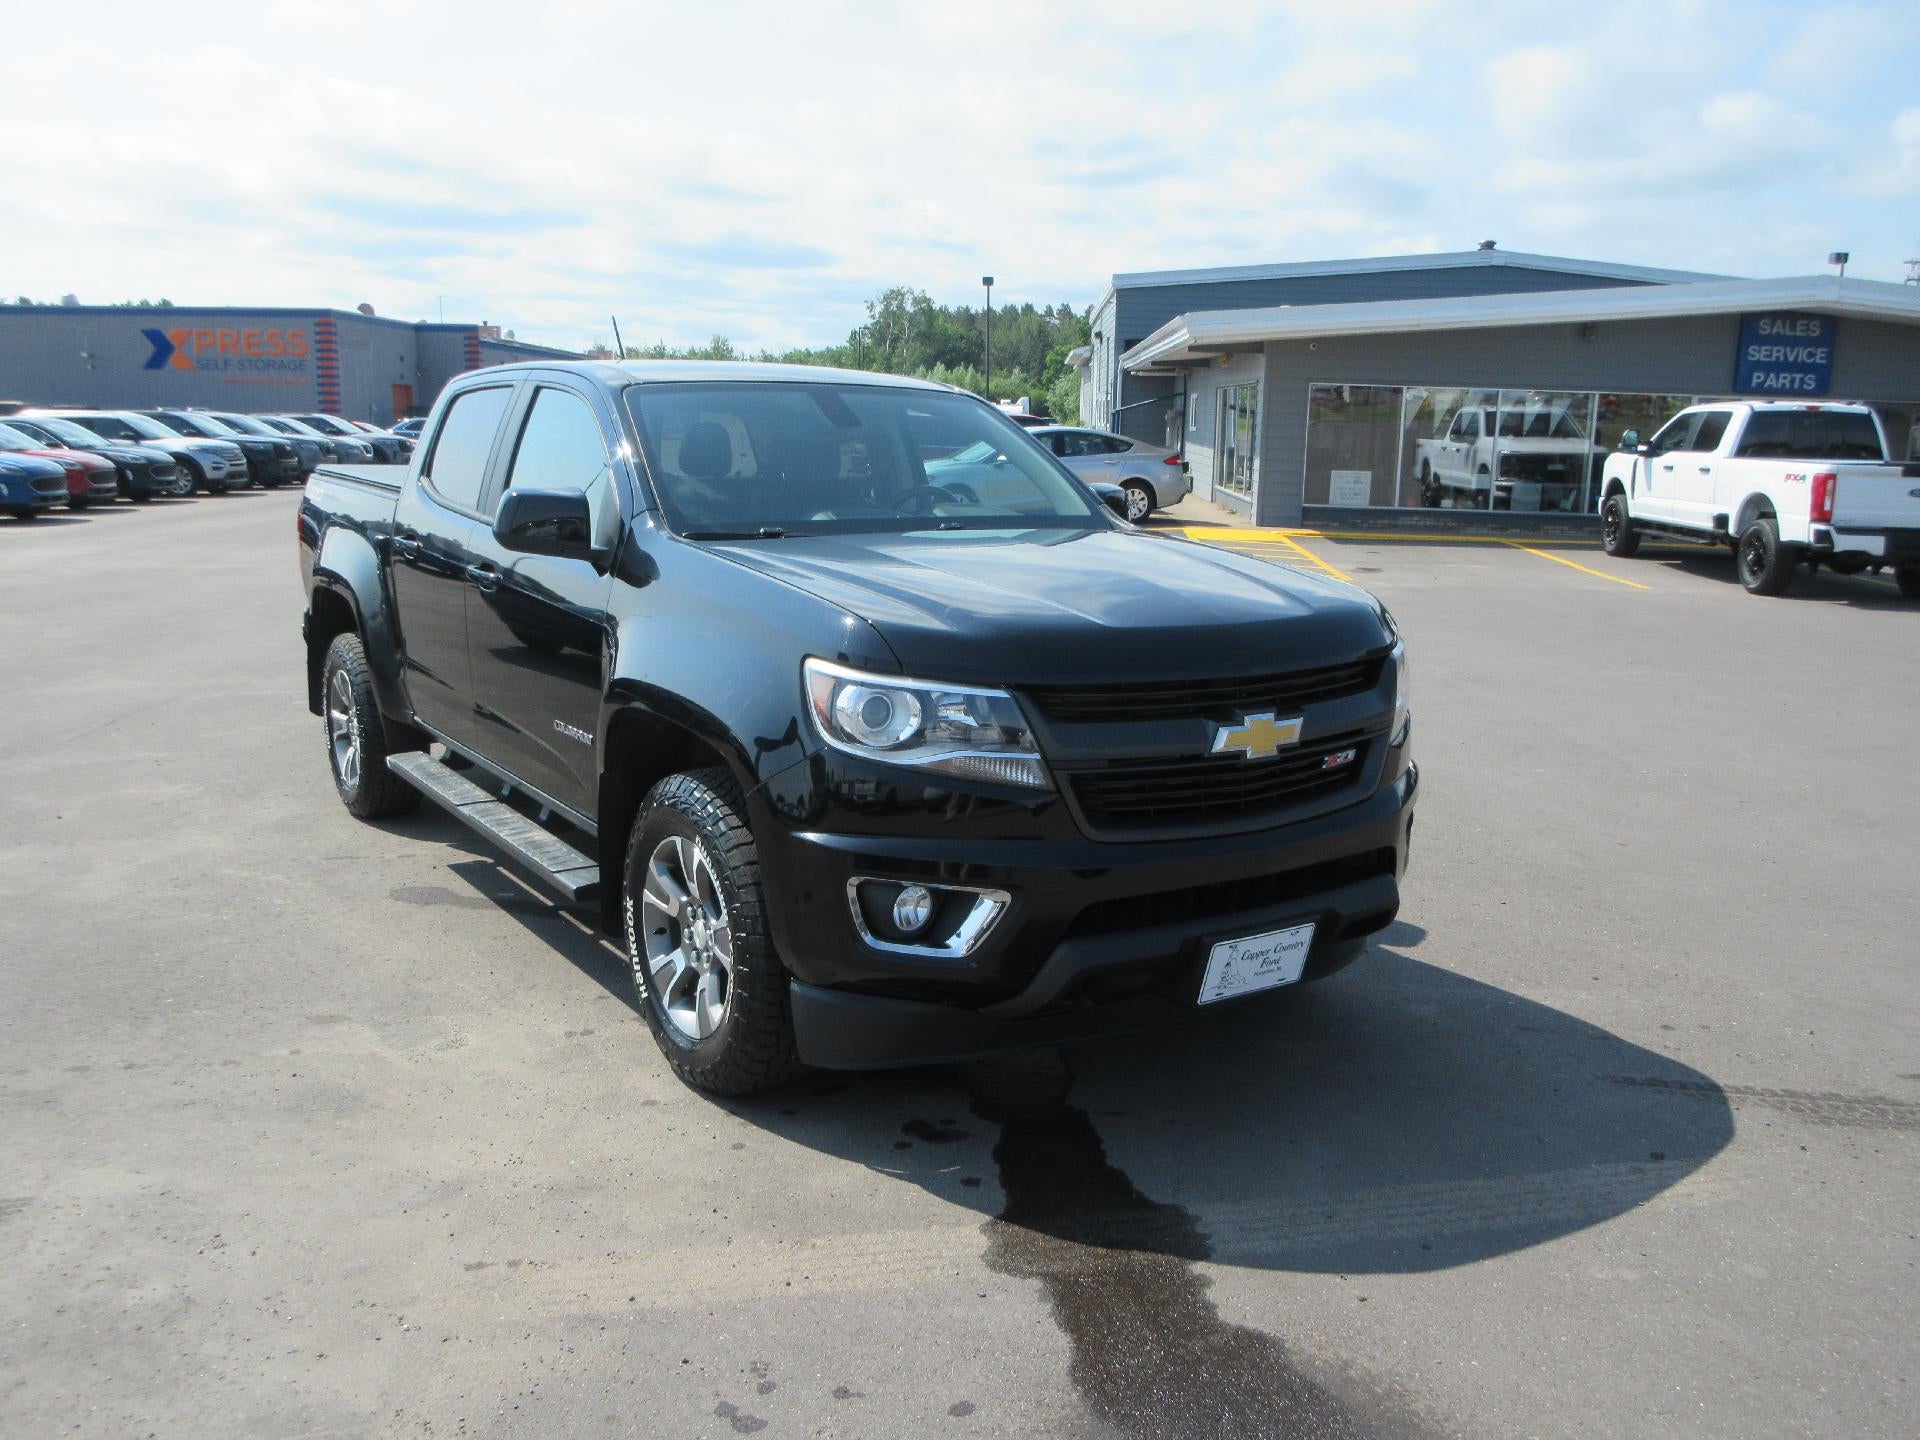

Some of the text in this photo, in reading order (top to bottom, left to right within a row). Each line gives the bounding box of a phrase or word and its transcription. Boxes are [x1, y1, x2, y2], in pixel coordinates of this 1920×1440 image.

[1758, 319, 1820, 336] SALES
[1747, 345, 1829, 364] SERVICE
[197, 359, 308, 372] SELF STORAGE
[1751, 372, 1817, 390] PARTS
[1241, 940, 1304, 961] Copper Country
[1260, 956, 1281, 969] Ford
